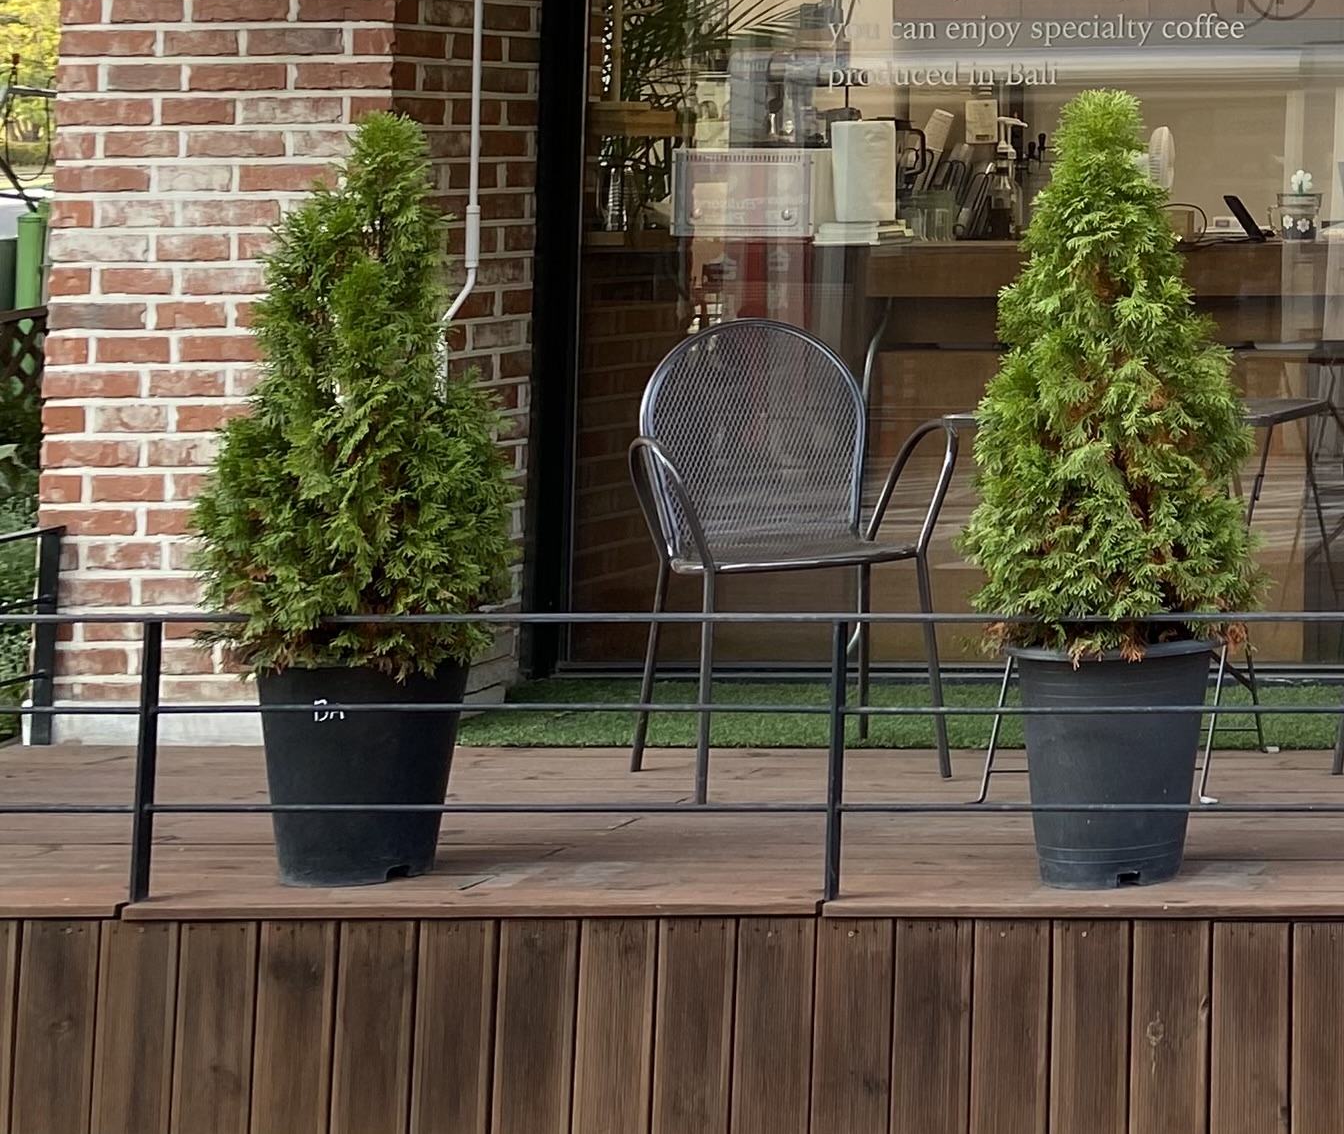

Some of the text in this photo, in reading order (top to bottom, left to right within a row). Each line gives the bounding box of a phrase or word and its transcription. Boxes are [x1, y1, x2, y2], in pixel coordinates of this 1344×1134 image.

[891, 22, 936, 41] can
[946, 15, 1020, 48] enjoy
[1031, 13, 1153, 48] specialty
[1162, 13, 1246, 41] coffee
[828, 60, 1058, 93] produced in Bali
